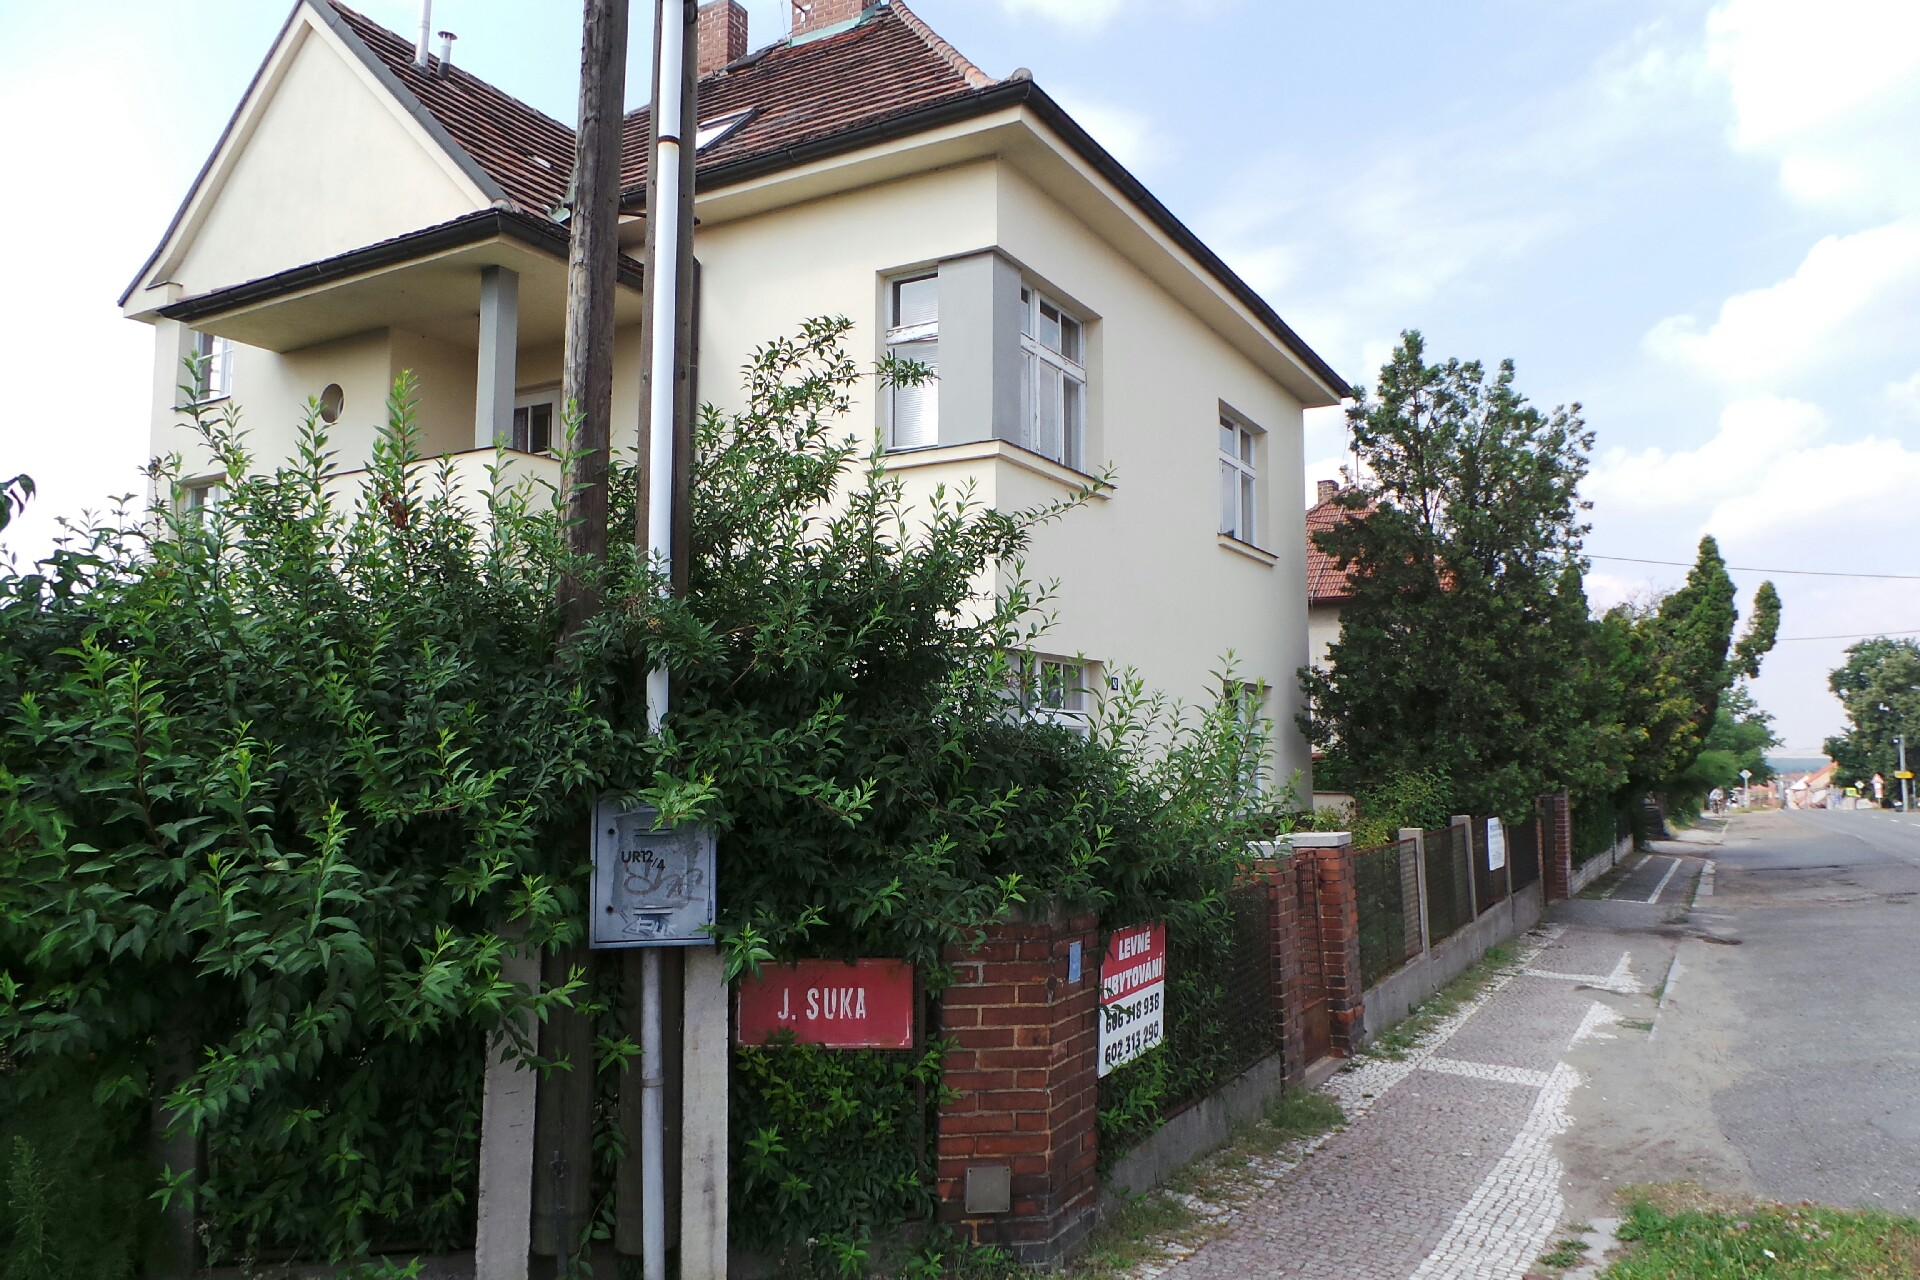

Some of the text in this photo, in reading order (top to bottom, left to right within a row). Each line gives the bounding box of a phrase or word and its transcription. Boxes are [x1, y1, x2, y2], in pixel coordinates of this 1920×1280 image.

[1118, 926, 1151, 961] LEVNÉ
[1103, 952, 1163, 1000] UBYTOVÁNÍ
[777, 987, 867, 1020] J. SUKA
[1143, 992, 1160, 1016] 938
[1105, 1020, 1159, 1065] 602 313 290
